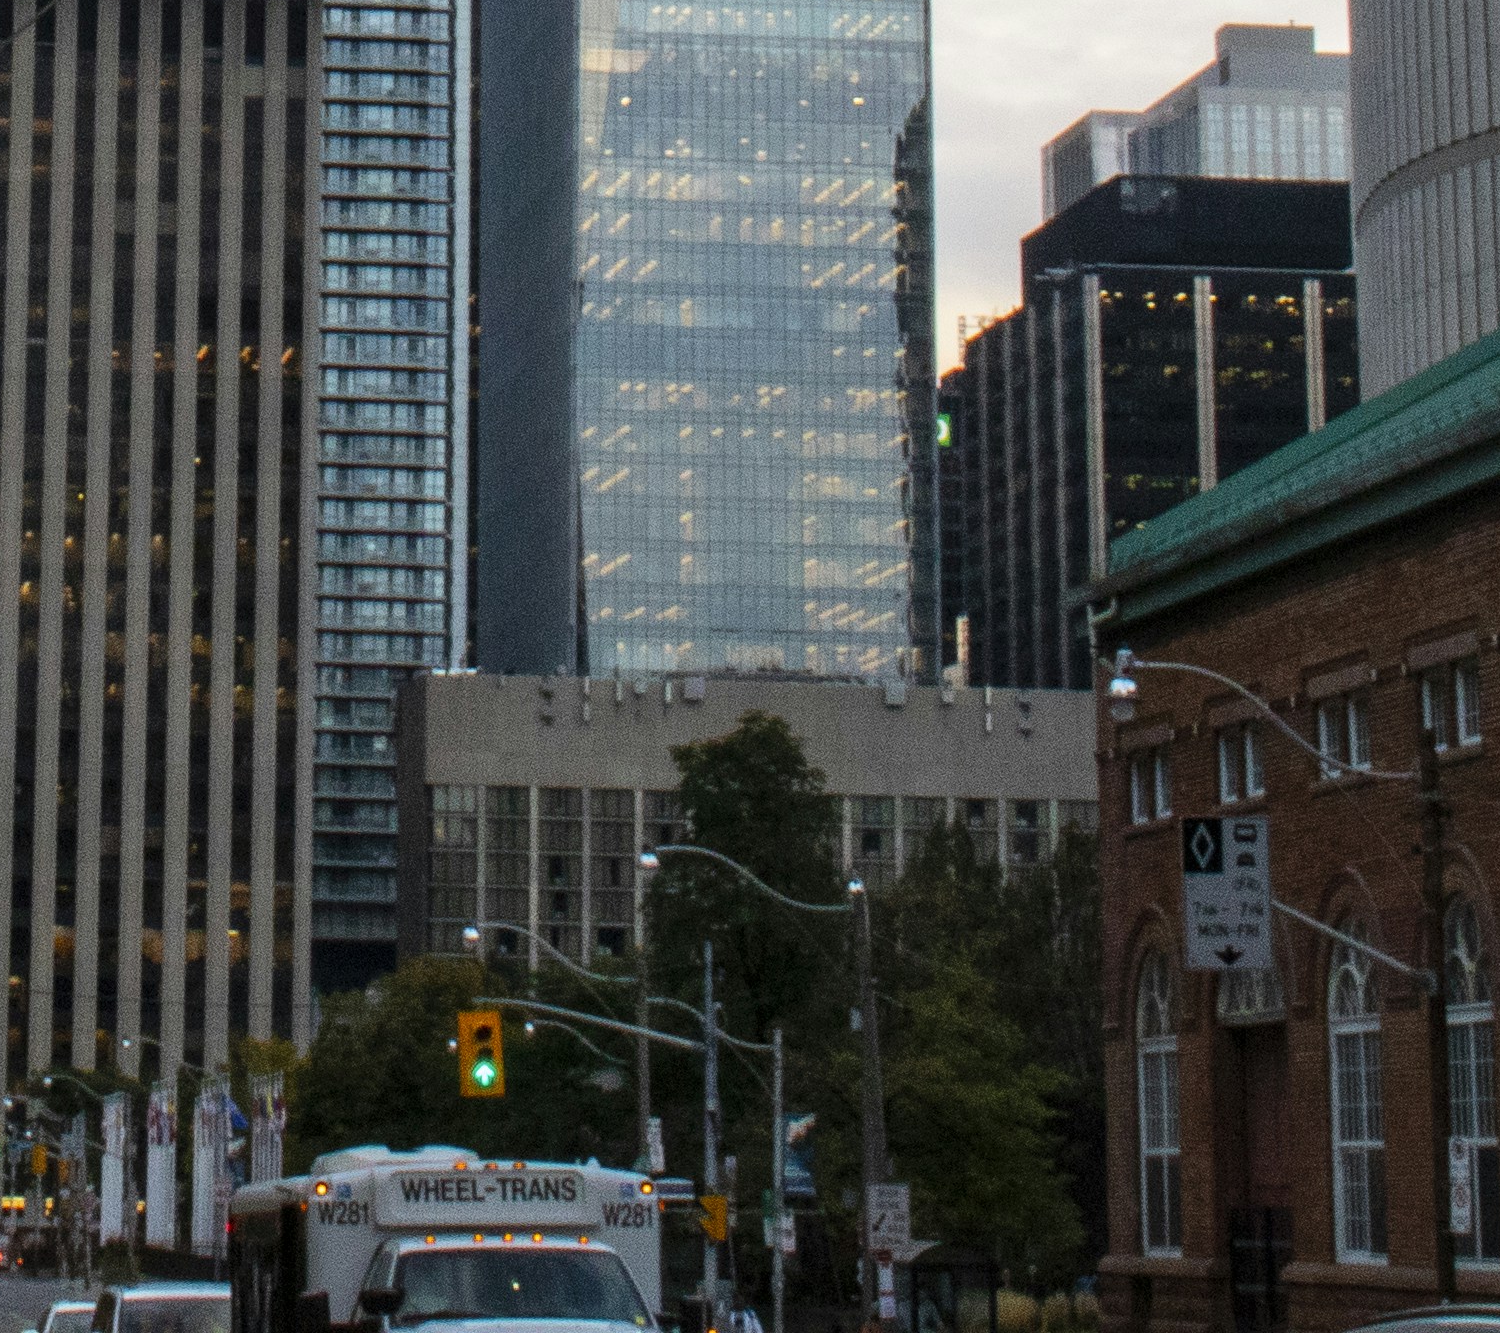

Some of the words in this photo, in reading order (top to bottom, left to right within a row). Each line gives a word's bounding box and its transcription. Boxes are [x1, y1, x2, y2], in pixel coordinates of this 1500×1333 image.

[400, 1177, 577, 1202] WHEEL-TRANS
[318, 1201, 369, 1225] W281
[602, 1202, 654, 1227] W281
